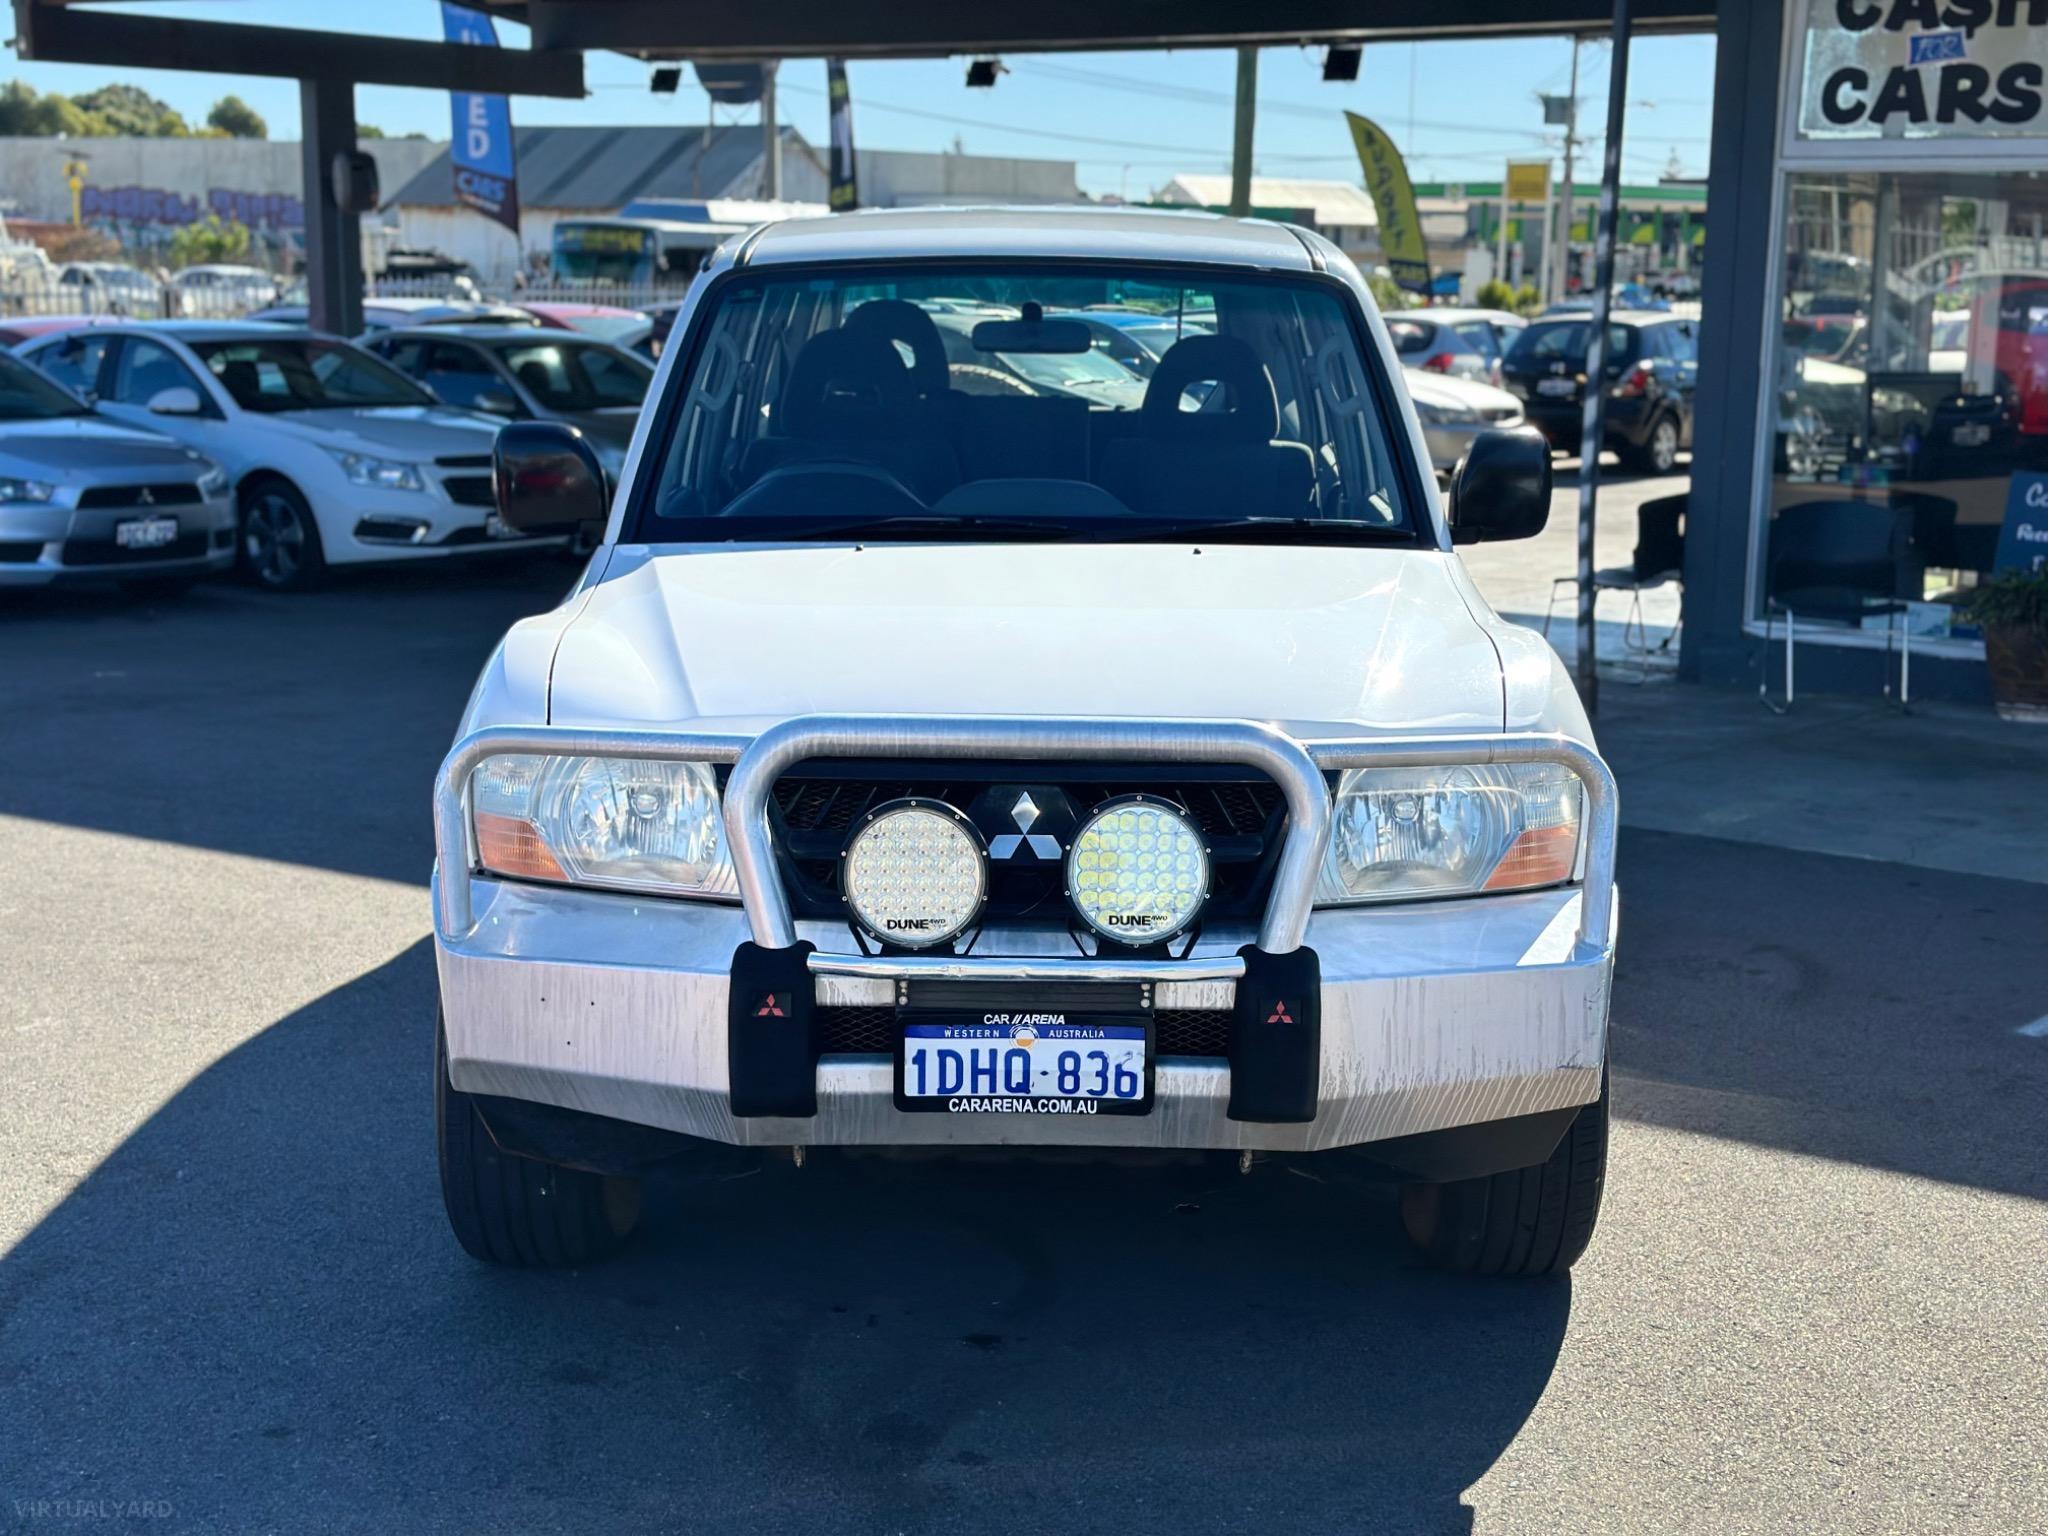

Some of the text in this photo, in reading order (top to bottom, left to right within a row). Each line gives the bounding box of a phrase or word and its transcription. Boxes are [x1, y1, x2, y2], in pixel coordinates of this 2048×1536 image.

[1821, 62, 2043, 125] CARS
[886, 918, 929, 930] DUNE
[1108, 914, 1152, 926] DUNE
[983, 1014, 1010, 1025] CAR
[944, 1028, 1105, 1039] WESTERN AUSTRALIA
[948, 1098, 1098, 1114] CARARENA.COM.AU
